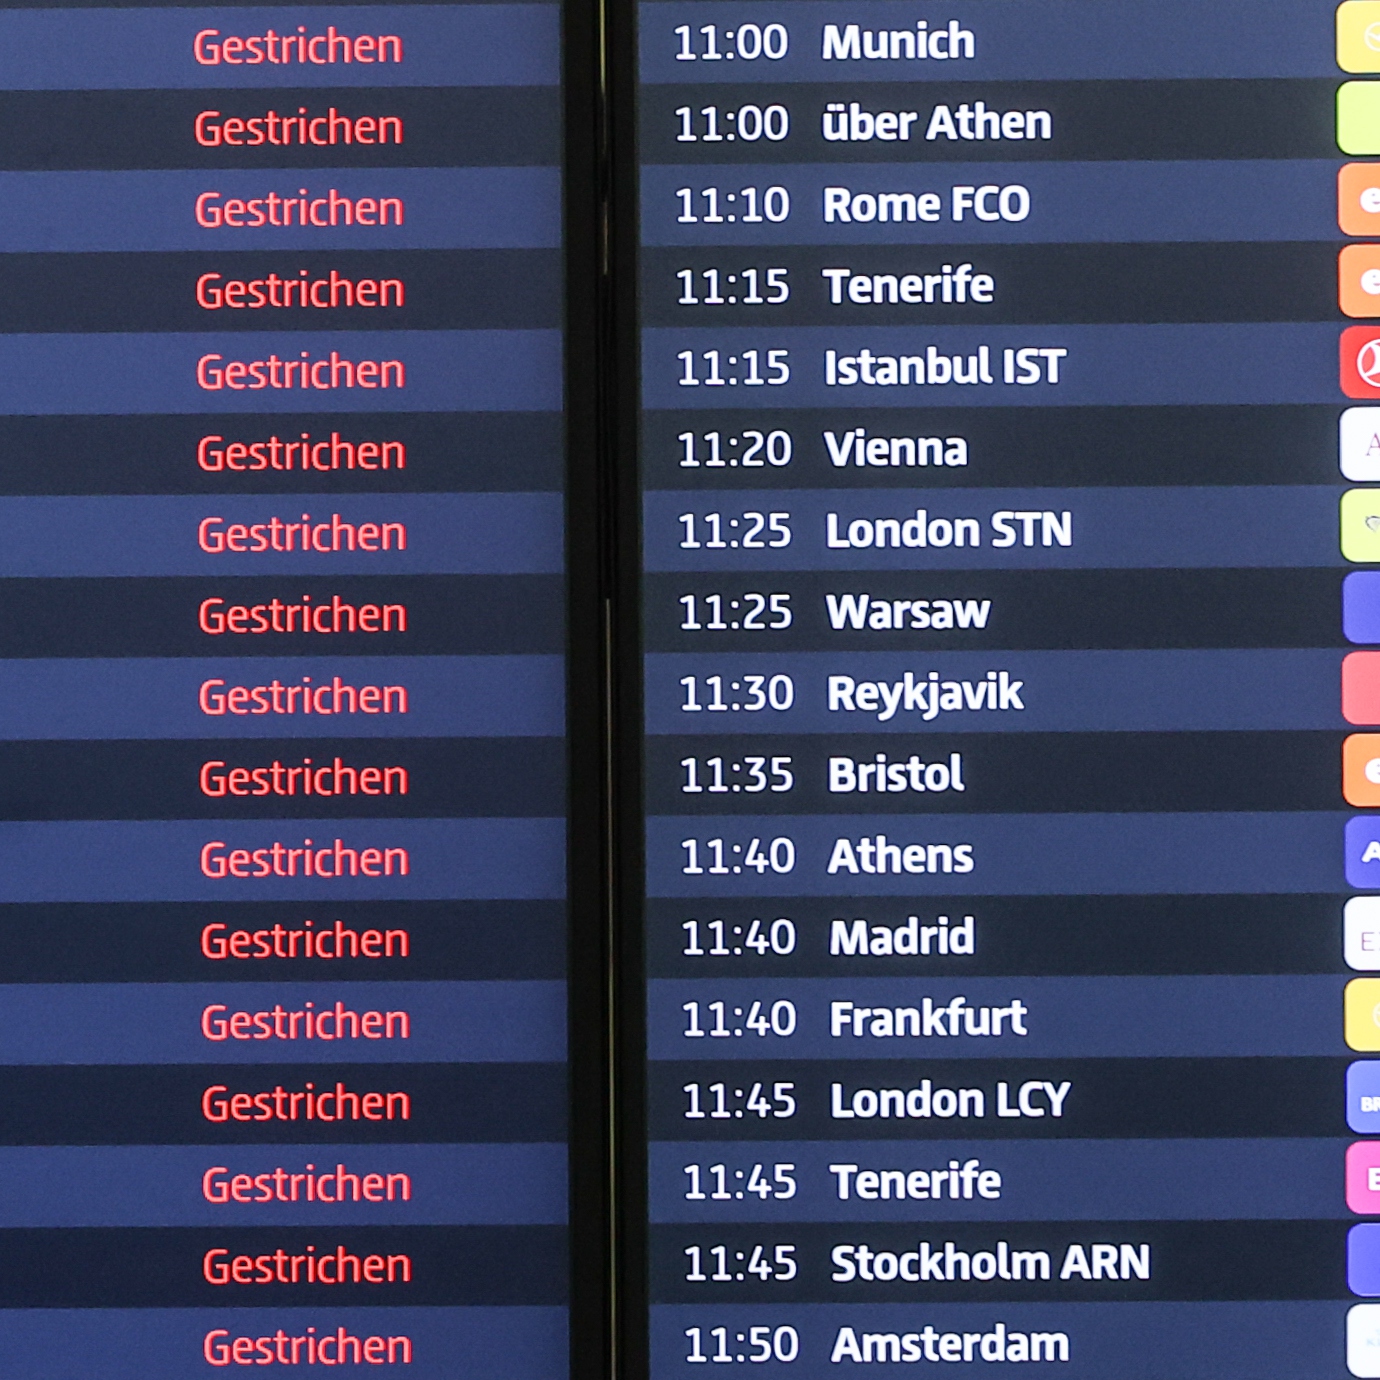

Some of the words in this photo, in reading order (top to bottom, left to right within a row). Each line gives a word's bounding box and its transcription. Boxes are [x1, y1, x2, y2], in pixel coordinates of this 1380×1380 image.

[675, 24, 787, 59] 11:00
[823, 21, 974, 59] Munich
[195, 108, 402, 146] Gestrichen
[824, 103, 917, 140] über
[926, 102, 1050, 139] Athen
[825, 188, 940, 221] Rome
[953, 185, 1029, 221] FCO
[678, 269, 788, 303] 11:15
[823, 264, 993, 303] Tenerife
[826, 346, 993, 385] Istanbul
[1005, 348, 1066, 384] IST
[198, 432, 405, 471] Gestrichen
[824, 429, 967, 466] Vienna
[680, 513, 790, 547] 11:25
[828, 510, 979, 547] London
[992, 512, 1071, 547] STN
[826, 595, 990, 629] Warsaw
[829, 672, 1024, 720] Reykjavik
[200, 758, 408, 797] Gestrichen
[682, 757, 792, 792] 11:35
[830, 754, 964, 791] Bristol
[828, 836, 973, 873] Athens
[831, 917, 973, 955] Madrid
[684, 1001, 795, 1036] 11:40
[832, 997, 1027, 1036] Frankfurt
[833, 1080, 983, 1117] London
[998, 1081, 1071, 1116] LCY
[203, 1164, 411, 1203] Gestrichen
[830, 1160, 1001, 1199] Tenerife
[686, 1246, 796, 1280] 11:45
[832, 1242, 1049, 1281] Stockholm
[1061, 1245, 1149, 1279] ARN
[832, 1324, 1068, 1362] Amsterdam
